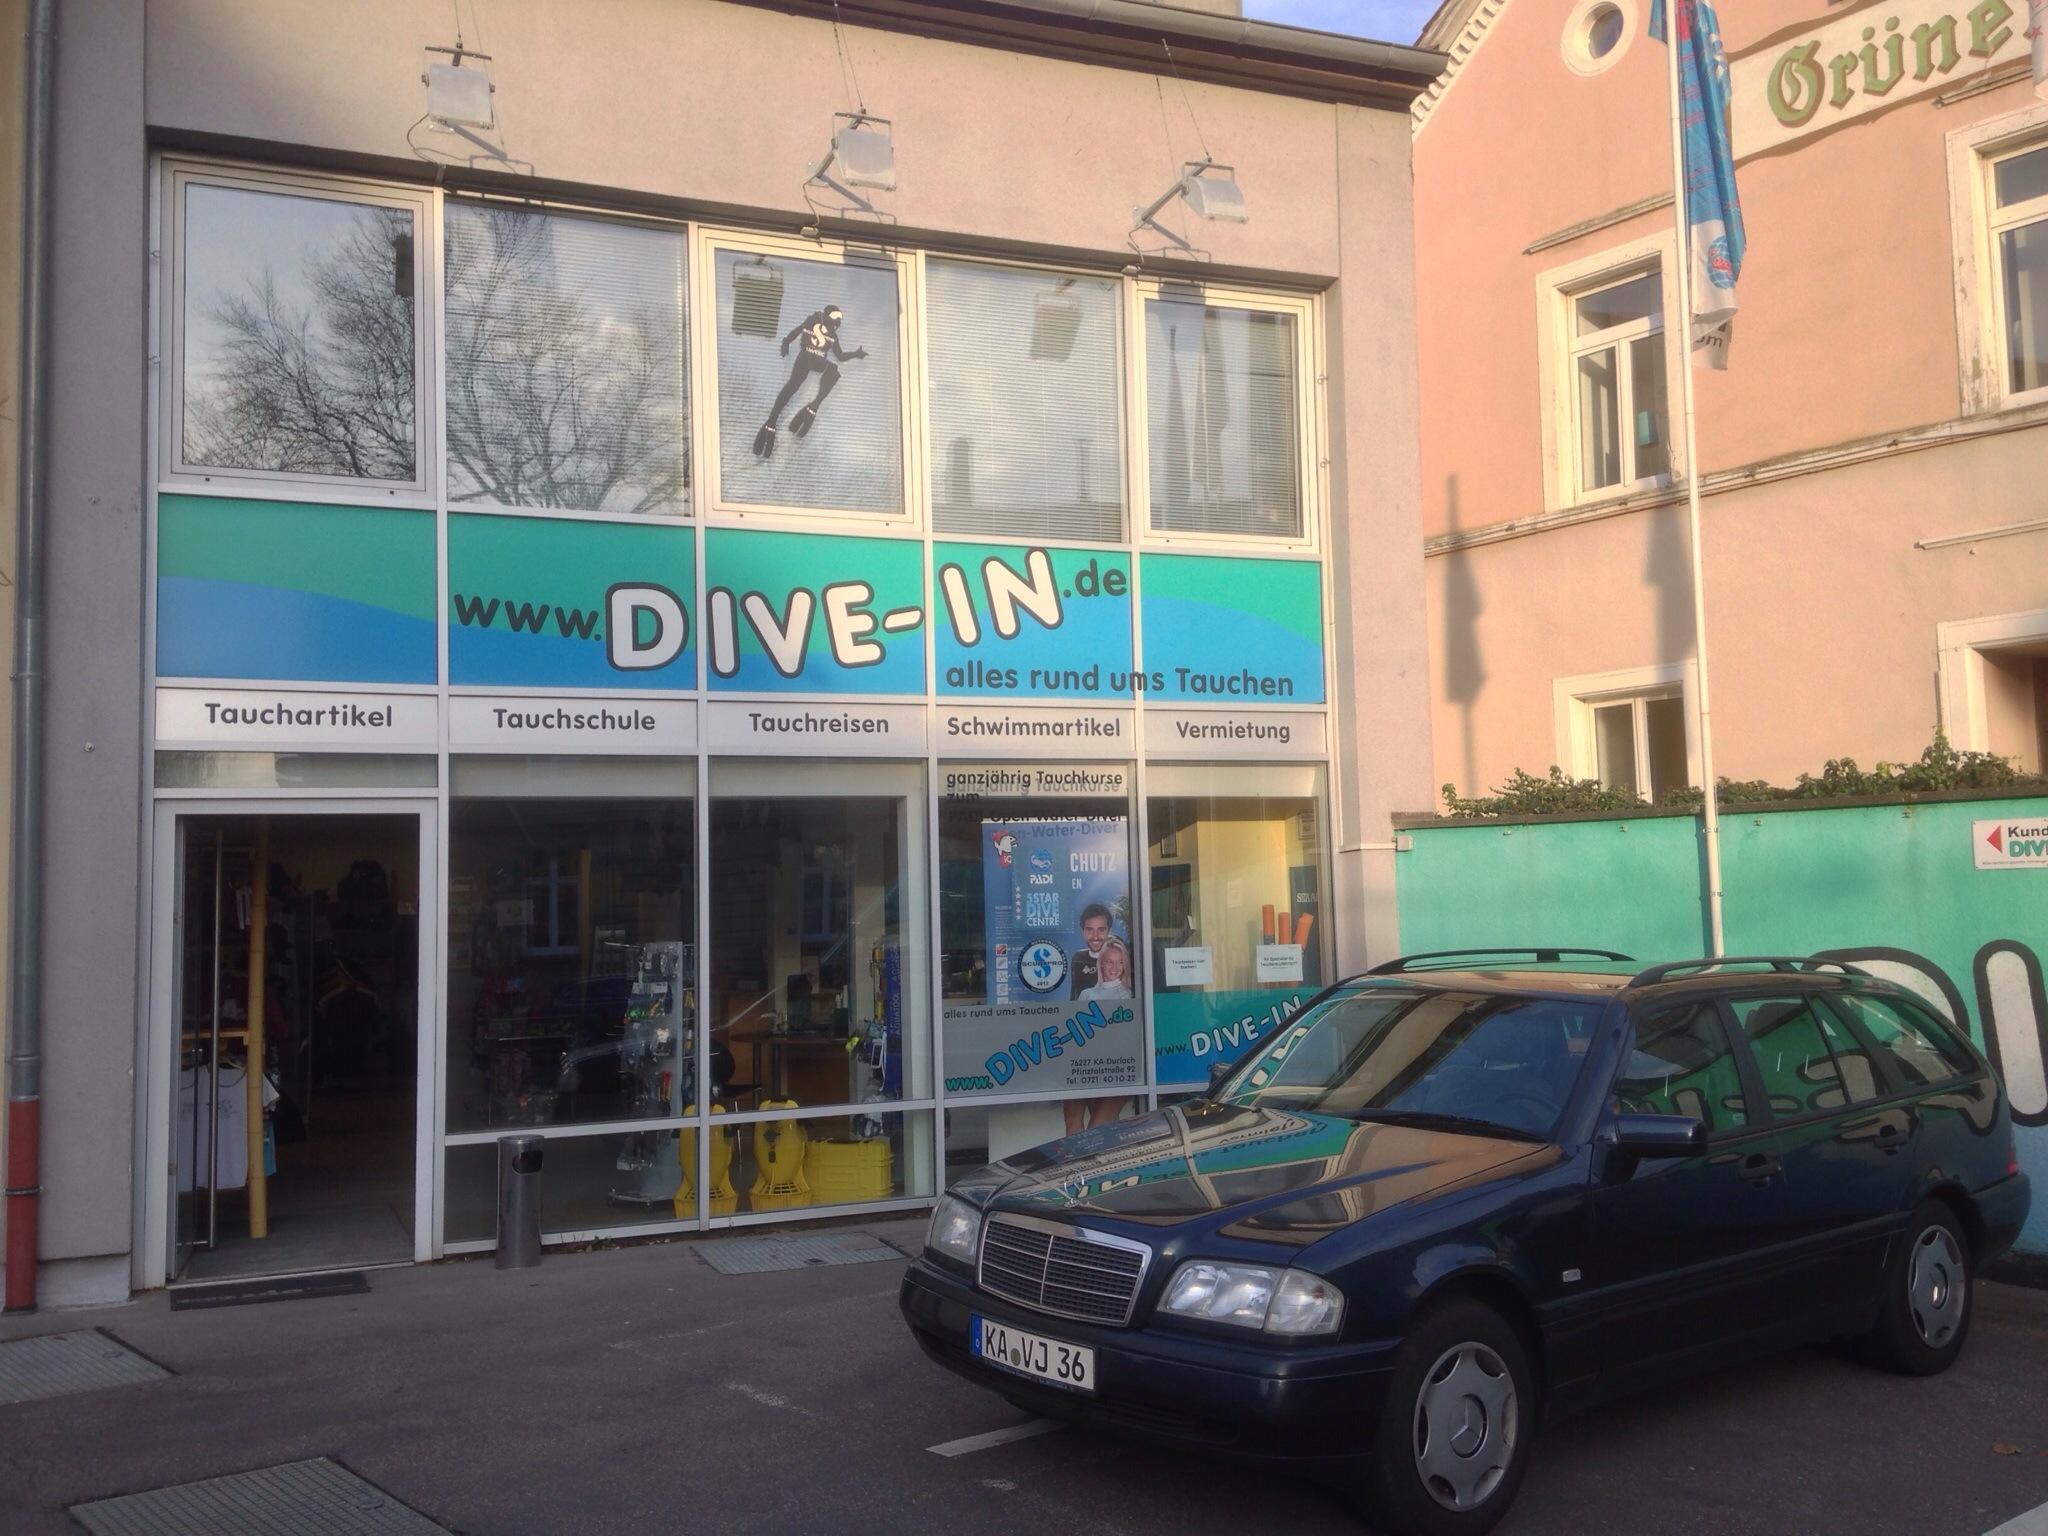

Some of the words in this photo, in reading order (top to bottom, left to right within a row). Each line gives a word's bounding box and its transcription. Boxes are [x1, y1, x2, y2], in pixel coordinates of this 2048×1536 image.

[1767, 0, 2031, 128] Grüne
[453, 546, 1128, 679] www.DIVE-IN.de
[946, 660, 1018, 689] alles
[1030, 664, 1099, 691] rund
[1110, 670, 1165, 692] ums
[1175, 667, 1294, 696] Tauchen
[204, 702, 392, 728] Tauchartikel
[493, 708, 656, 731] Tauchschule
[749, 713, 889, 734] Tauchreisen
[947, 716, 1121, 738] Schwimmartikel
[1176, 721, 1291, 744] Vermietung
[946, 769, 1031, 788] ganzjährig
[1036, 770, 1123, 785] Tauchkurse
[1070, 852, 1116, 872] CHUTZ
[1029, 874, 1054, 885] PADI
[1071, 878, 1082, 890] EN
[1026, 903, 1060, 918] DIVE
[1026, 917, 1060, 927] CENTRE
[944, 1008, 967, 1020] alles
[969, 1007, 993, 1018] rund
[996, 1008, 1017, 1017] ums
[1019, 1005, 1060, 1015] Tauchen
[945, 1000, 1134, 1092] www.DIVE-IN.de
[985, 1324, 1008, 1361] KA
[1021, 1336, 1048, 1373] VJ
[1057, 1346, 1085, 1382] 36
